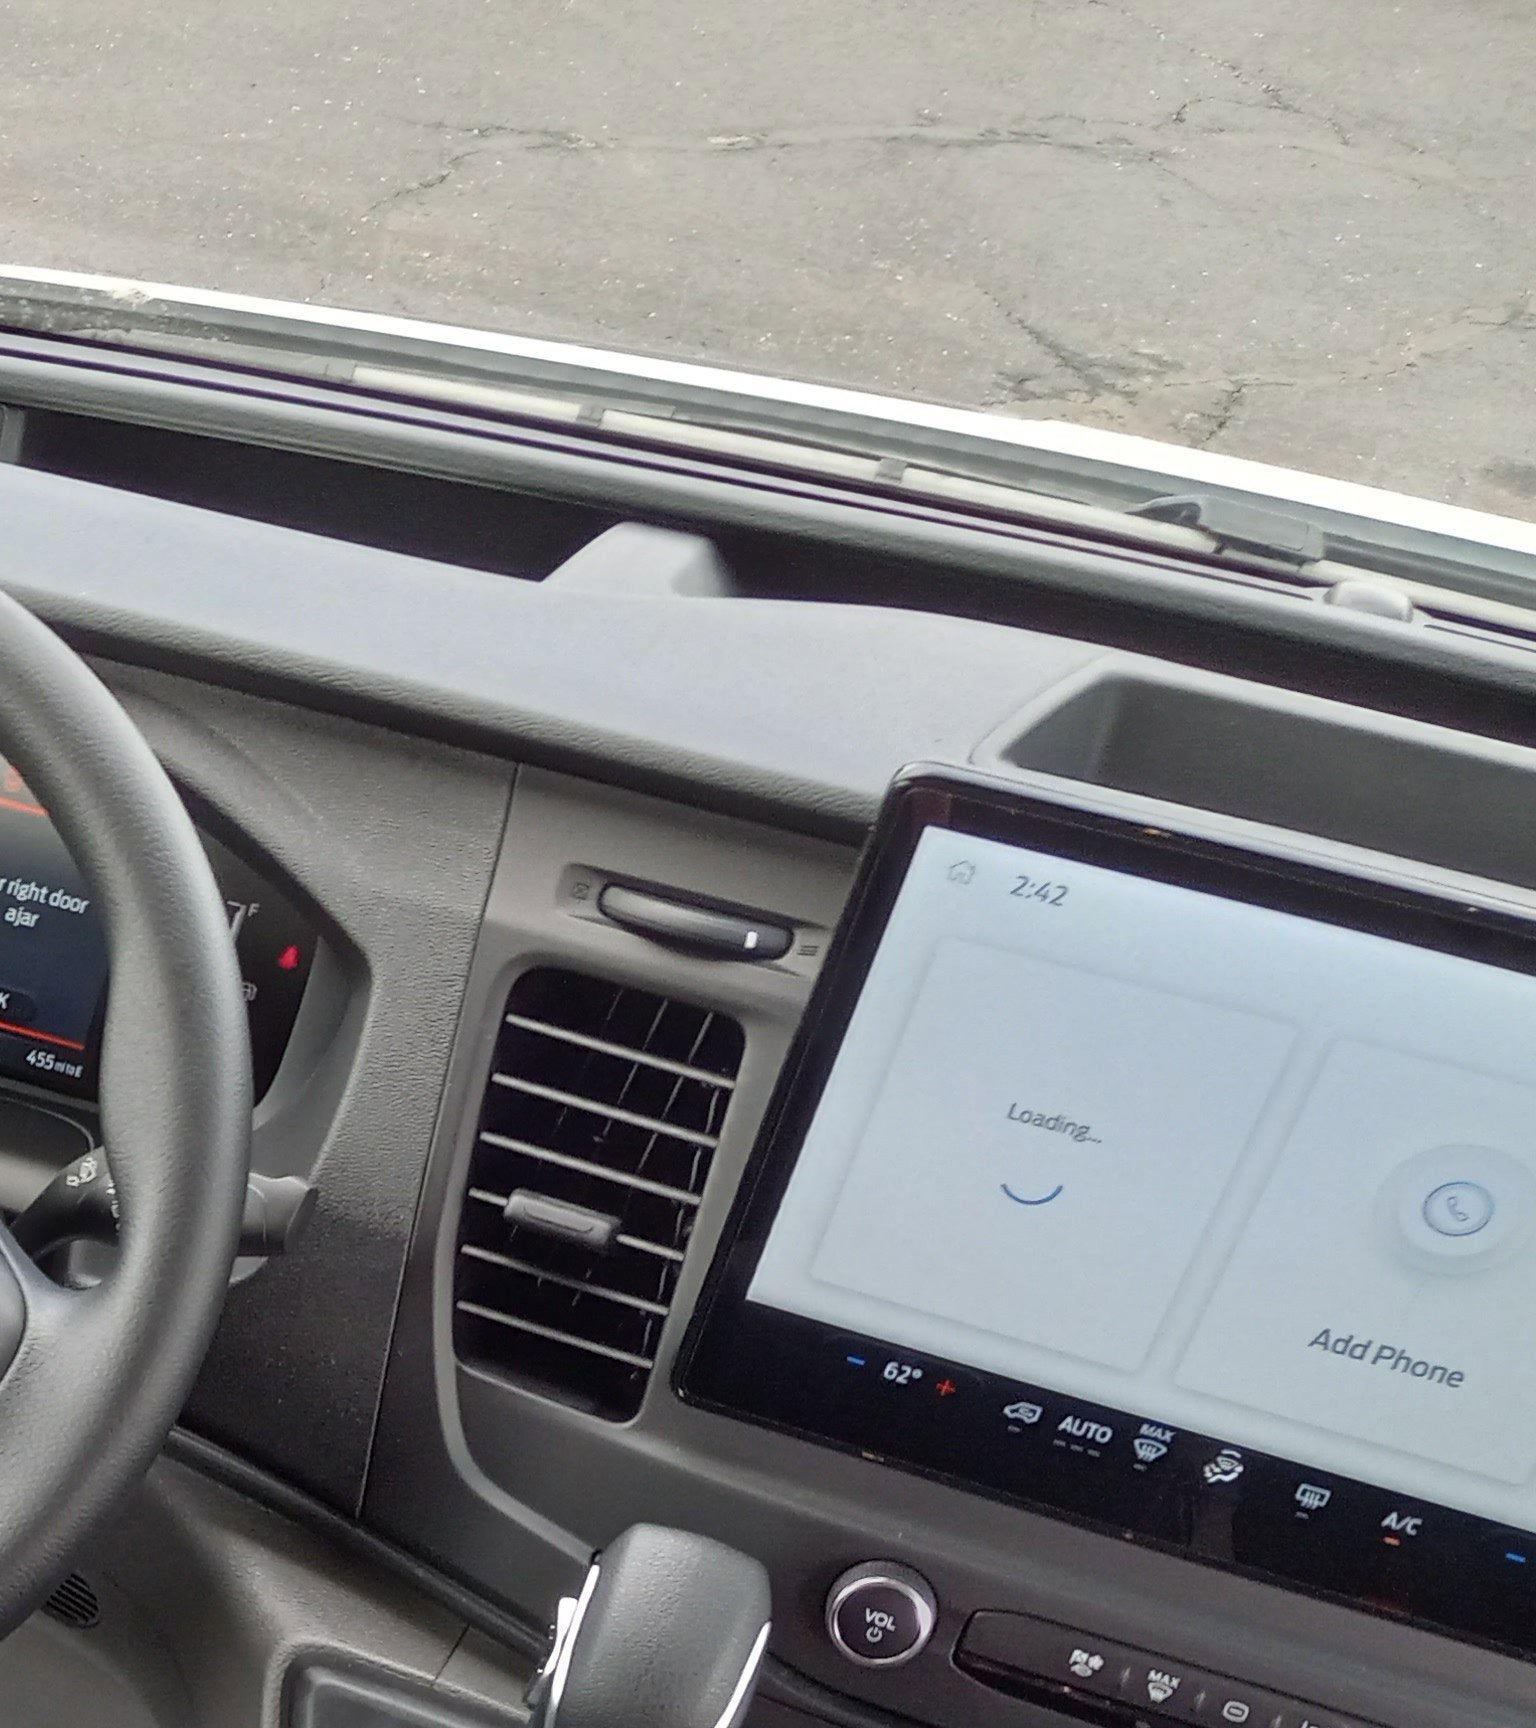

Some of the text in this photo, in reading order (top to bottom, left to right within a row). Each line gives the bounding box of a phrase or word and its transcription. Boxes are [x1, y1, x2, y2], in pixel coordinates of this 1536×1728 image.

[6, 880, 49, 904] right
[48, 887, 90, 915] door
[1009, 875, 1070, 908] 2:42
[4, 905, 40, 929] ajar
[1307, 1327, 1465, 1388] Add Phone
[1057, 1414, 1114, 1445] AUTO
[1138, 1422, 1176, 1443] MAX
[1380, 1510, 1423, 1538] A/C
[863, 1606, 896, 1632] VOL
[1147, 1669, 1181, 1690] MAX
